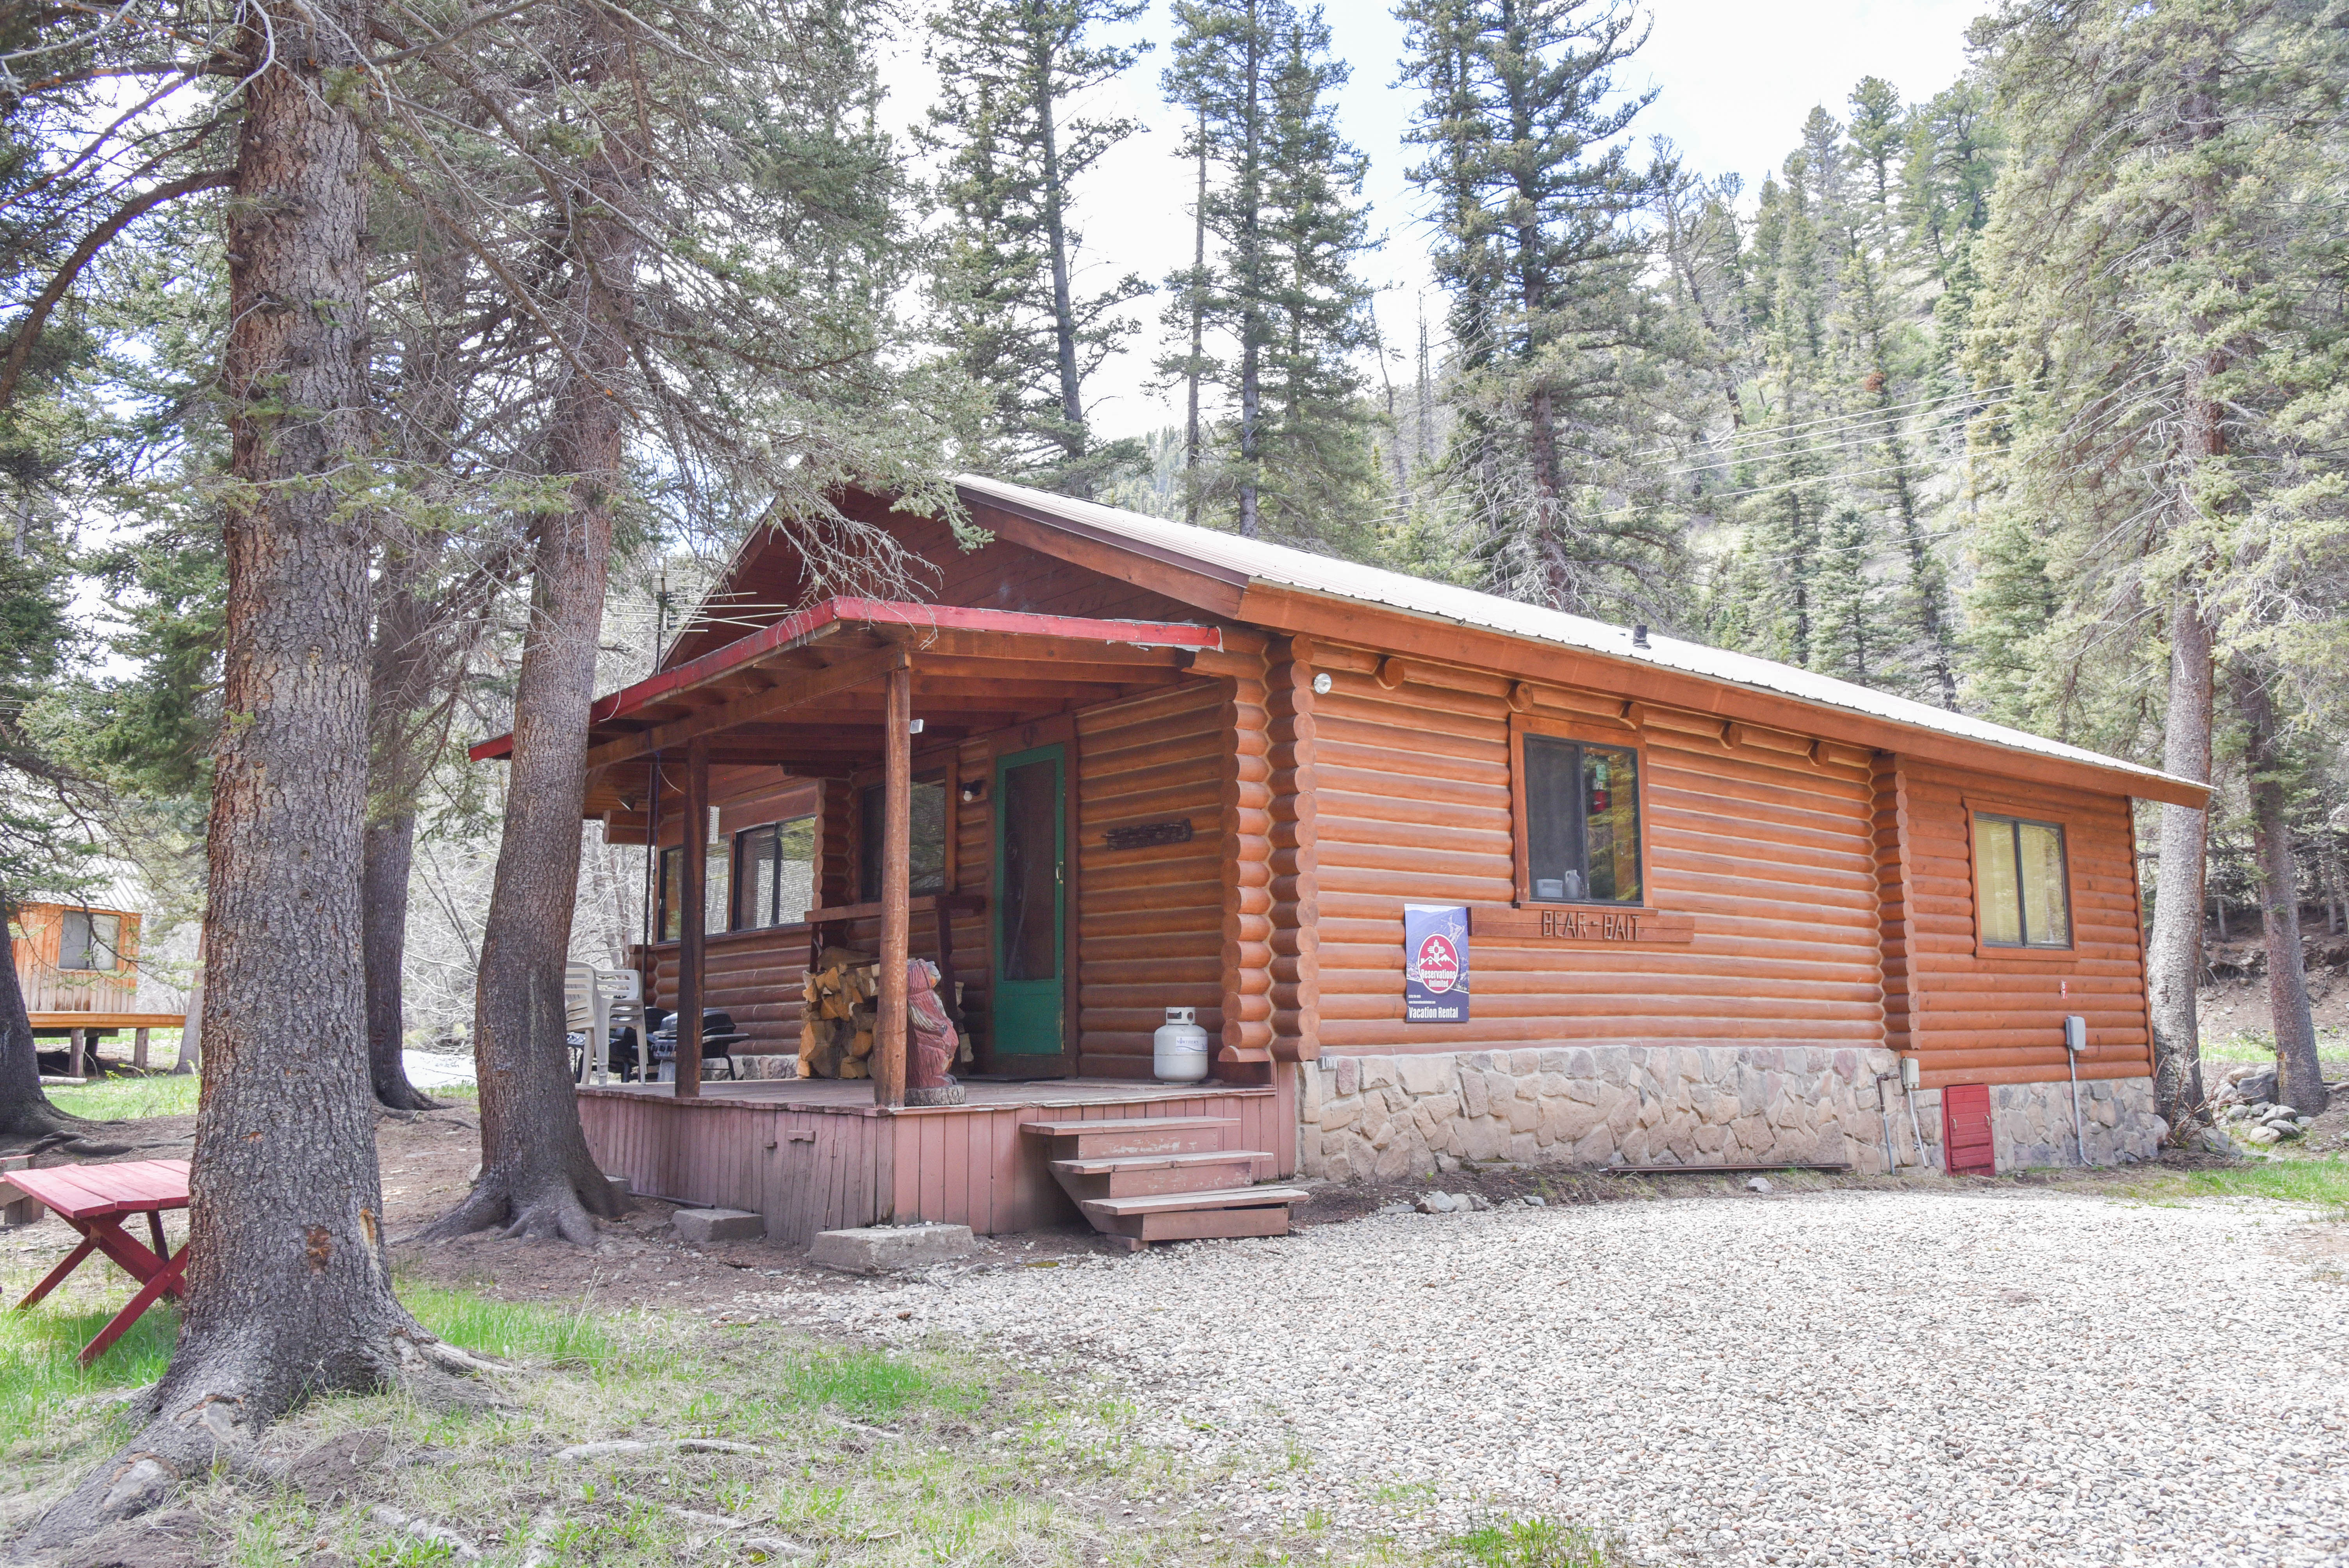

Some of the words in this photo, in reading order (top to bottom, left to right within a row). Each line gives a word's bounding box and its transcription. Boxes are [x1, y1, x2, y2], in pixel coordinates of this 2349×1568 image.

[1421, 969, 1456, 979] Reservations
[1429, 979, 1449, 987] Unlimited
[1409, 1006, 1437, 1018] Vacation
[1438, 1007, 1458, 1018] Rental
